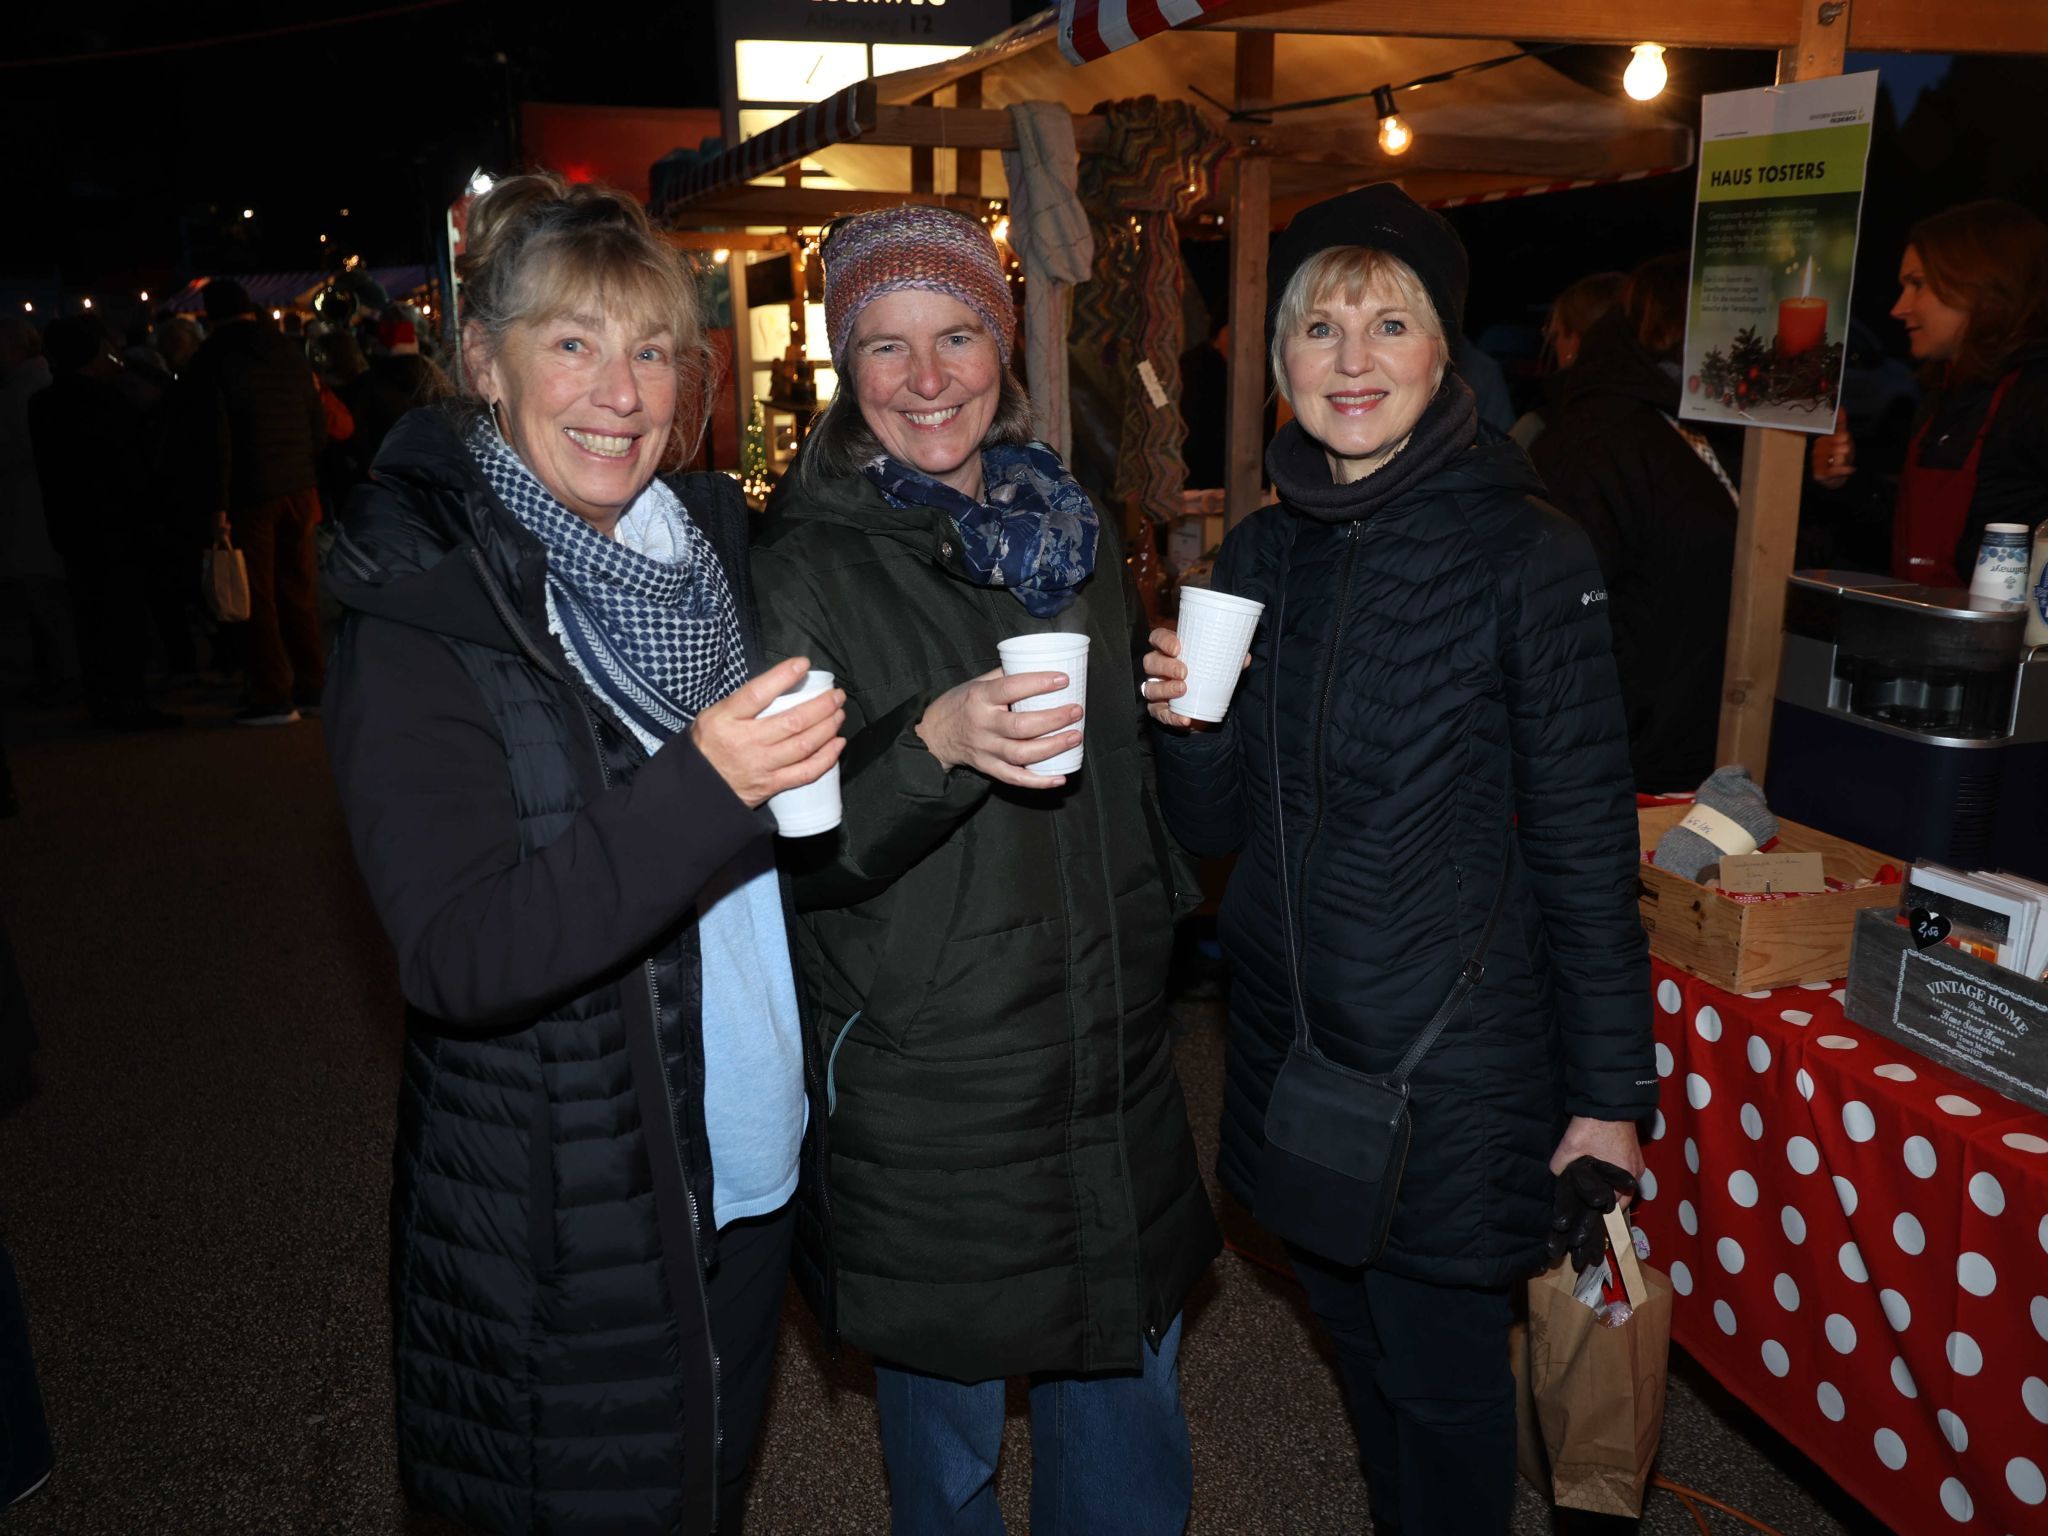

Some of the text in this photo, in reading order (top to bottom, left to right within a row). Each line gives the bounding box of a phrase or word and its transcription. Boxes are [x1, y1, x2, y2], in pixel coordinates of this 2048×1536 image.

[910, 13, 933, 34] 12
[1711, 161, 1826, 187] HAUS TOSTERS
[1917, 920, 1939, 939] 2,50
[1926, 980, 2030, 1036] VINTAGE HOME
[1940, 1008, 1962, 1026] Home
[1983, 1028, 2006, 1046] Home
[1946, 1029, 1996, 1057] Old Town Market
